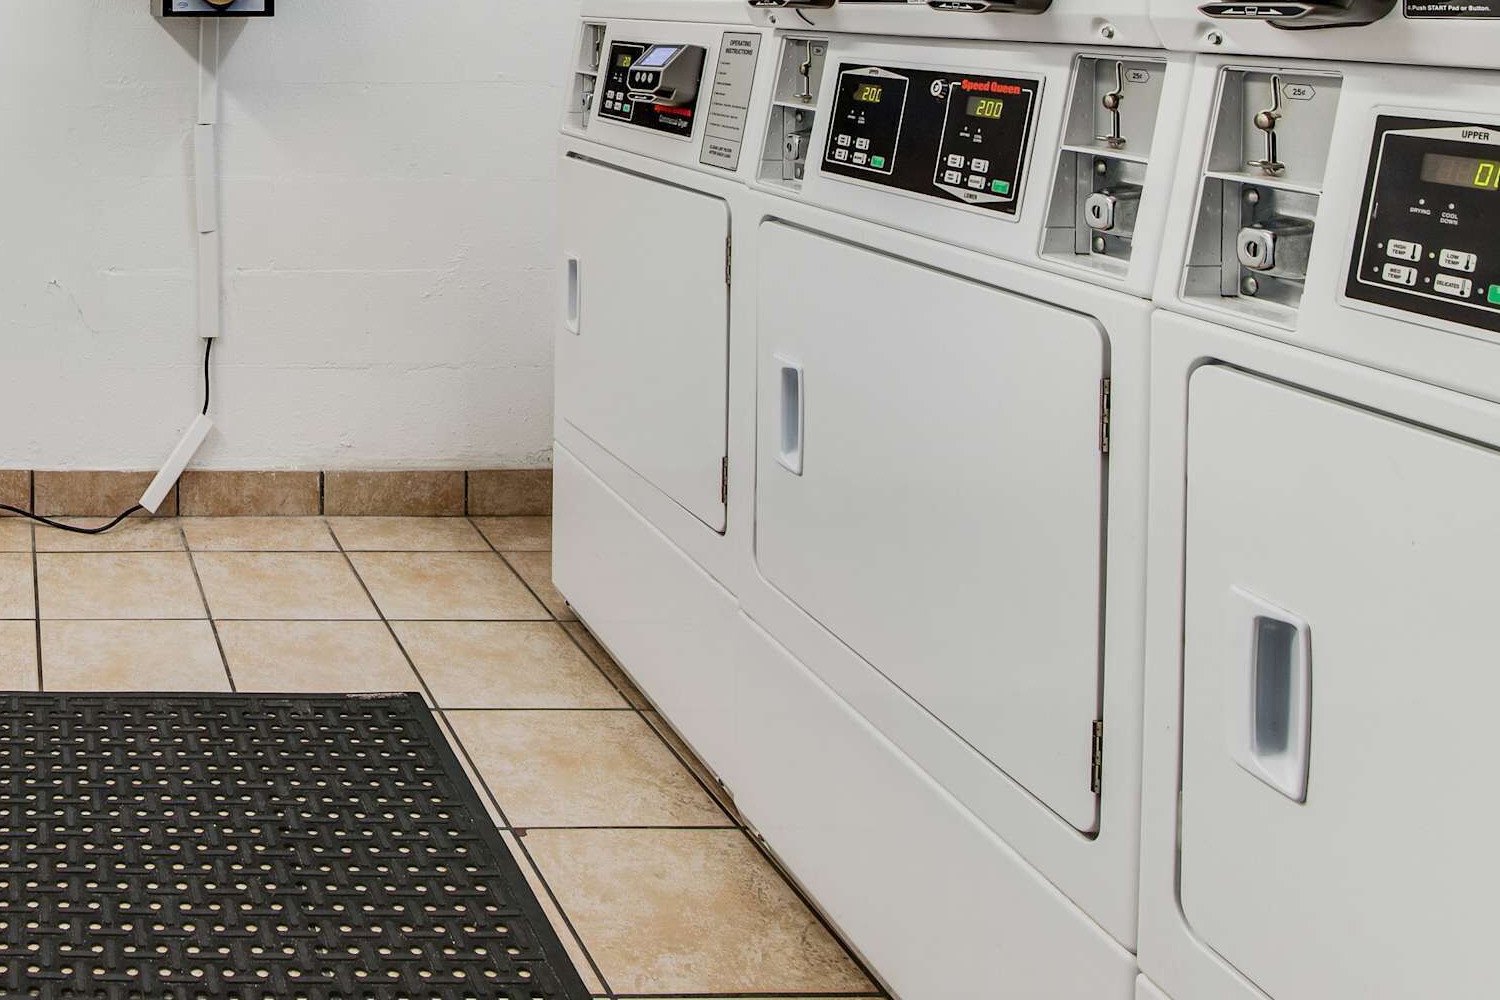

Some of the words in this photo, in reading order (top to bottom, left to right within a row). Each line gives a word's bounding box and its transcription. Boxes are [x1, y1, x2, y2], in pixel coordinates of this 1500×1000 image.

[961, 79, 990, 92] Speed
[991, 81, 1020, 95] Queen
[976, 100, 1003, 118] 200
[1461, 129, 1490, 141] UPPER
[1410, 207, 1431, 215] DRYING
